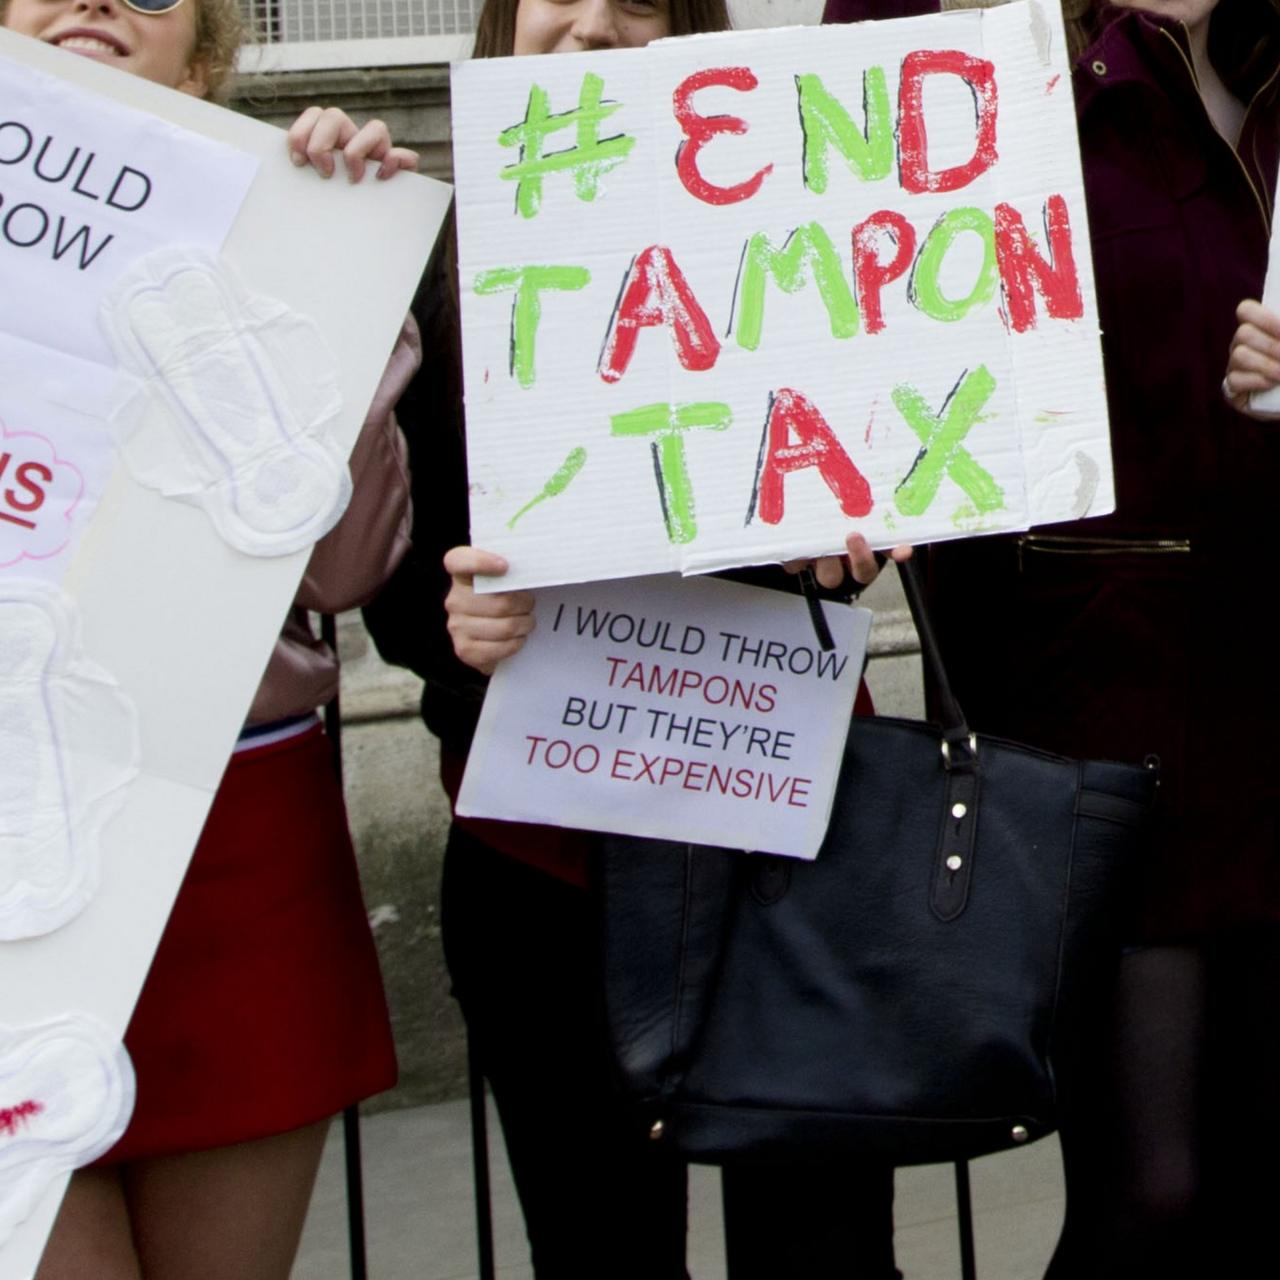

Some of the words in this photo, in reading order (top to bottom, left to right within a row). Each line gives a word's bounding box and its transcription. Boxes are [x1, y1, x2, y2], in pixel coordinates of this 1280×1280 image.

[472, 194, 1084, 390] TAMPON
[609, 364, 1005, 543] TAX
[552, 603, 566, 632] I
[576, 606, 706, 656] WOULD
[718, 631, 849, 682] THROW
[605, 656, 778, 713] TAMPONS
[562, 696, 637, 734] BUT
[646, 708, 796, 761] THEY'RE
[525, 735, 600, 774] TOO
[609, 749, 812, 808] EXPENSIVE
